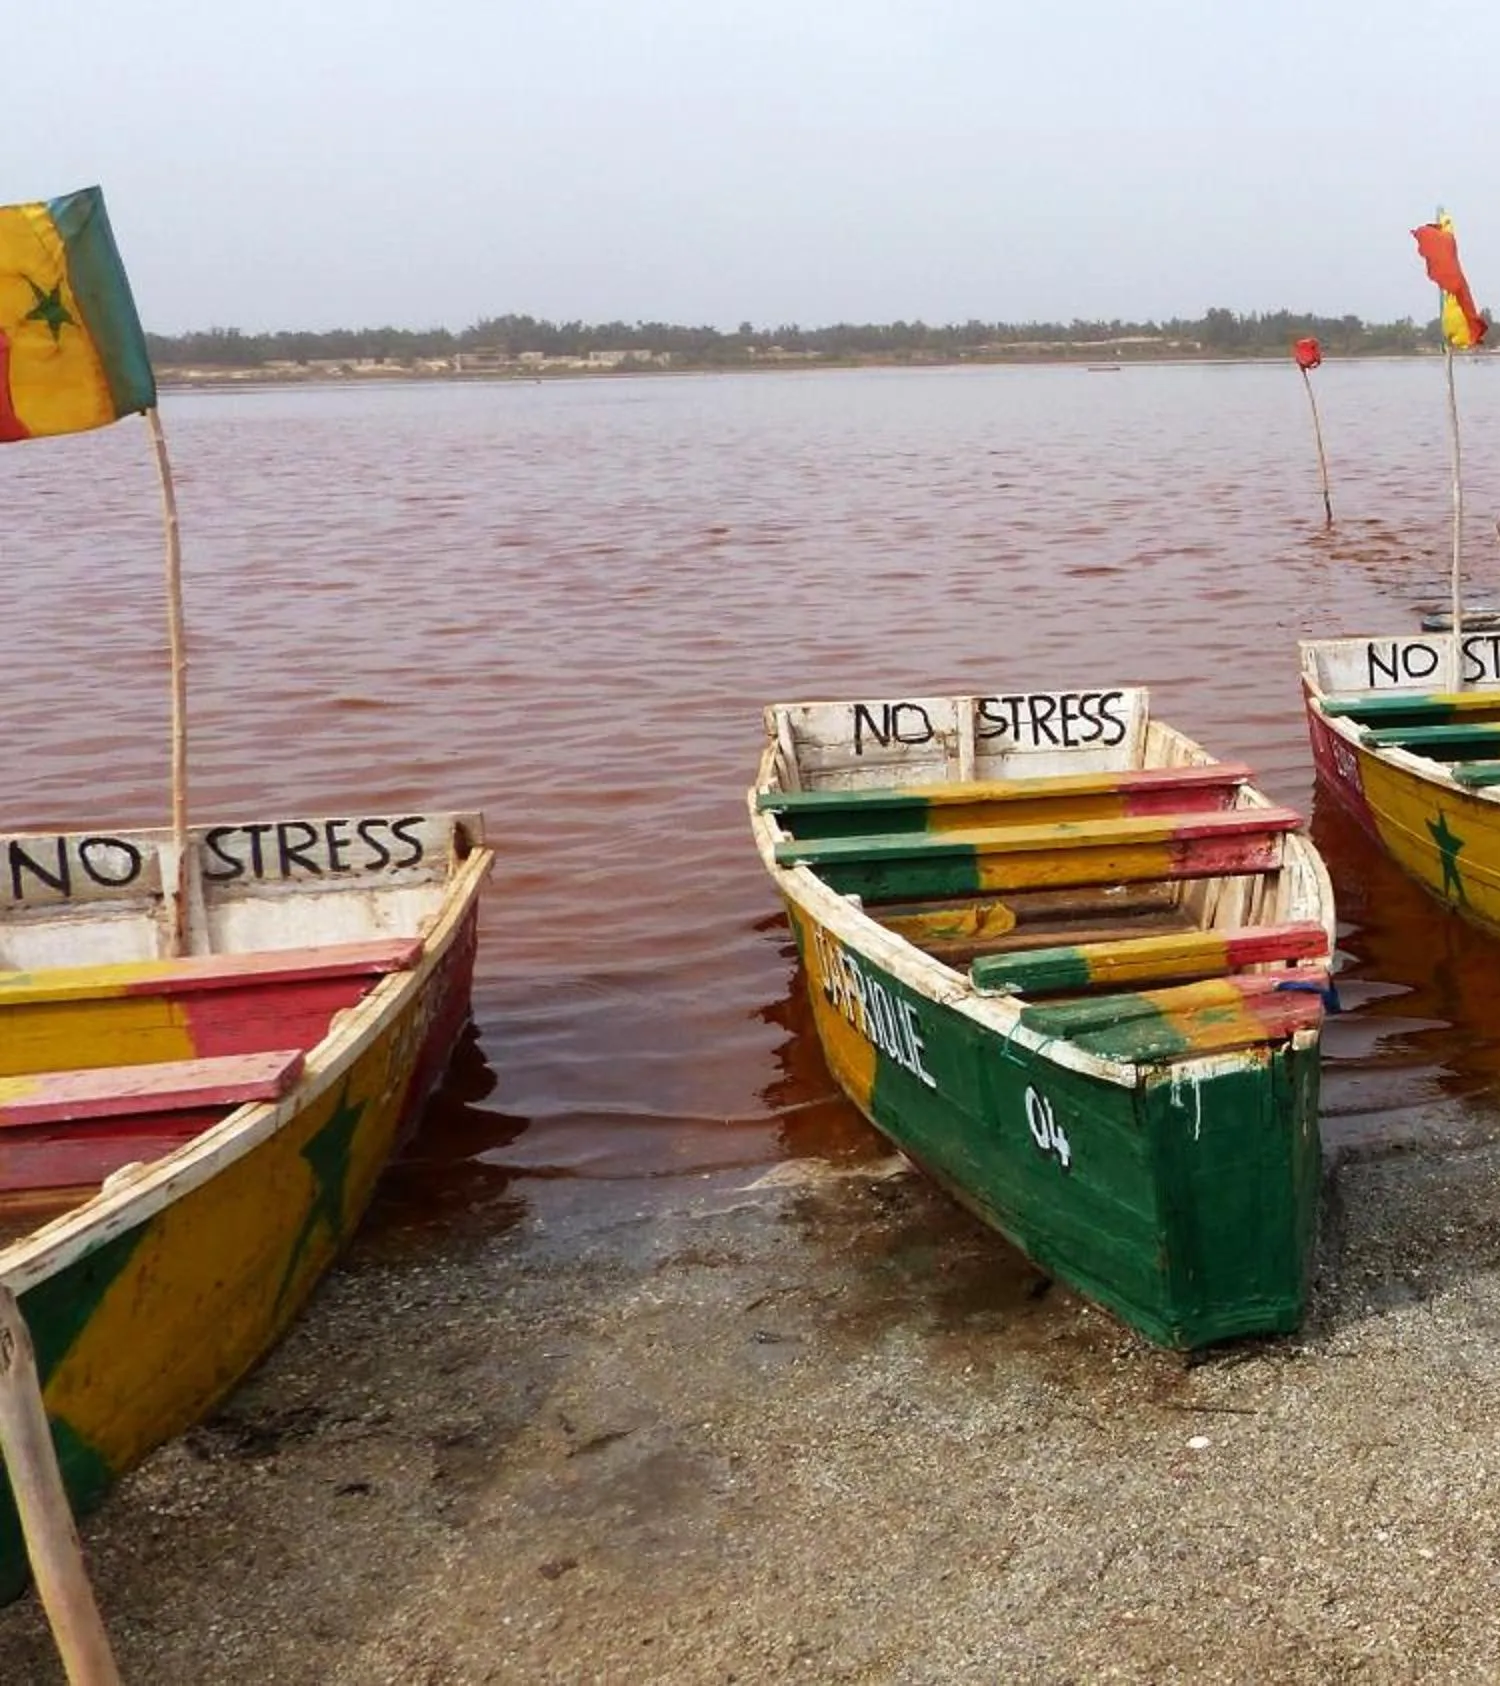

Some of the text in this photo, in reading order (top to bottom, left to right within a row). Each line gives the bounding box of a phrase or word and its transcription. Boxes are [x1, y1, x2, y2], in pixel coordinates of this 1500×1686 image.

[1367, 641, 1439, 688] NO
[852, 691, 1127, 756] NO STRESS
[8, 816, 427, 900] NO STRESS
[1024, 1084, 1072, 1168] 04
